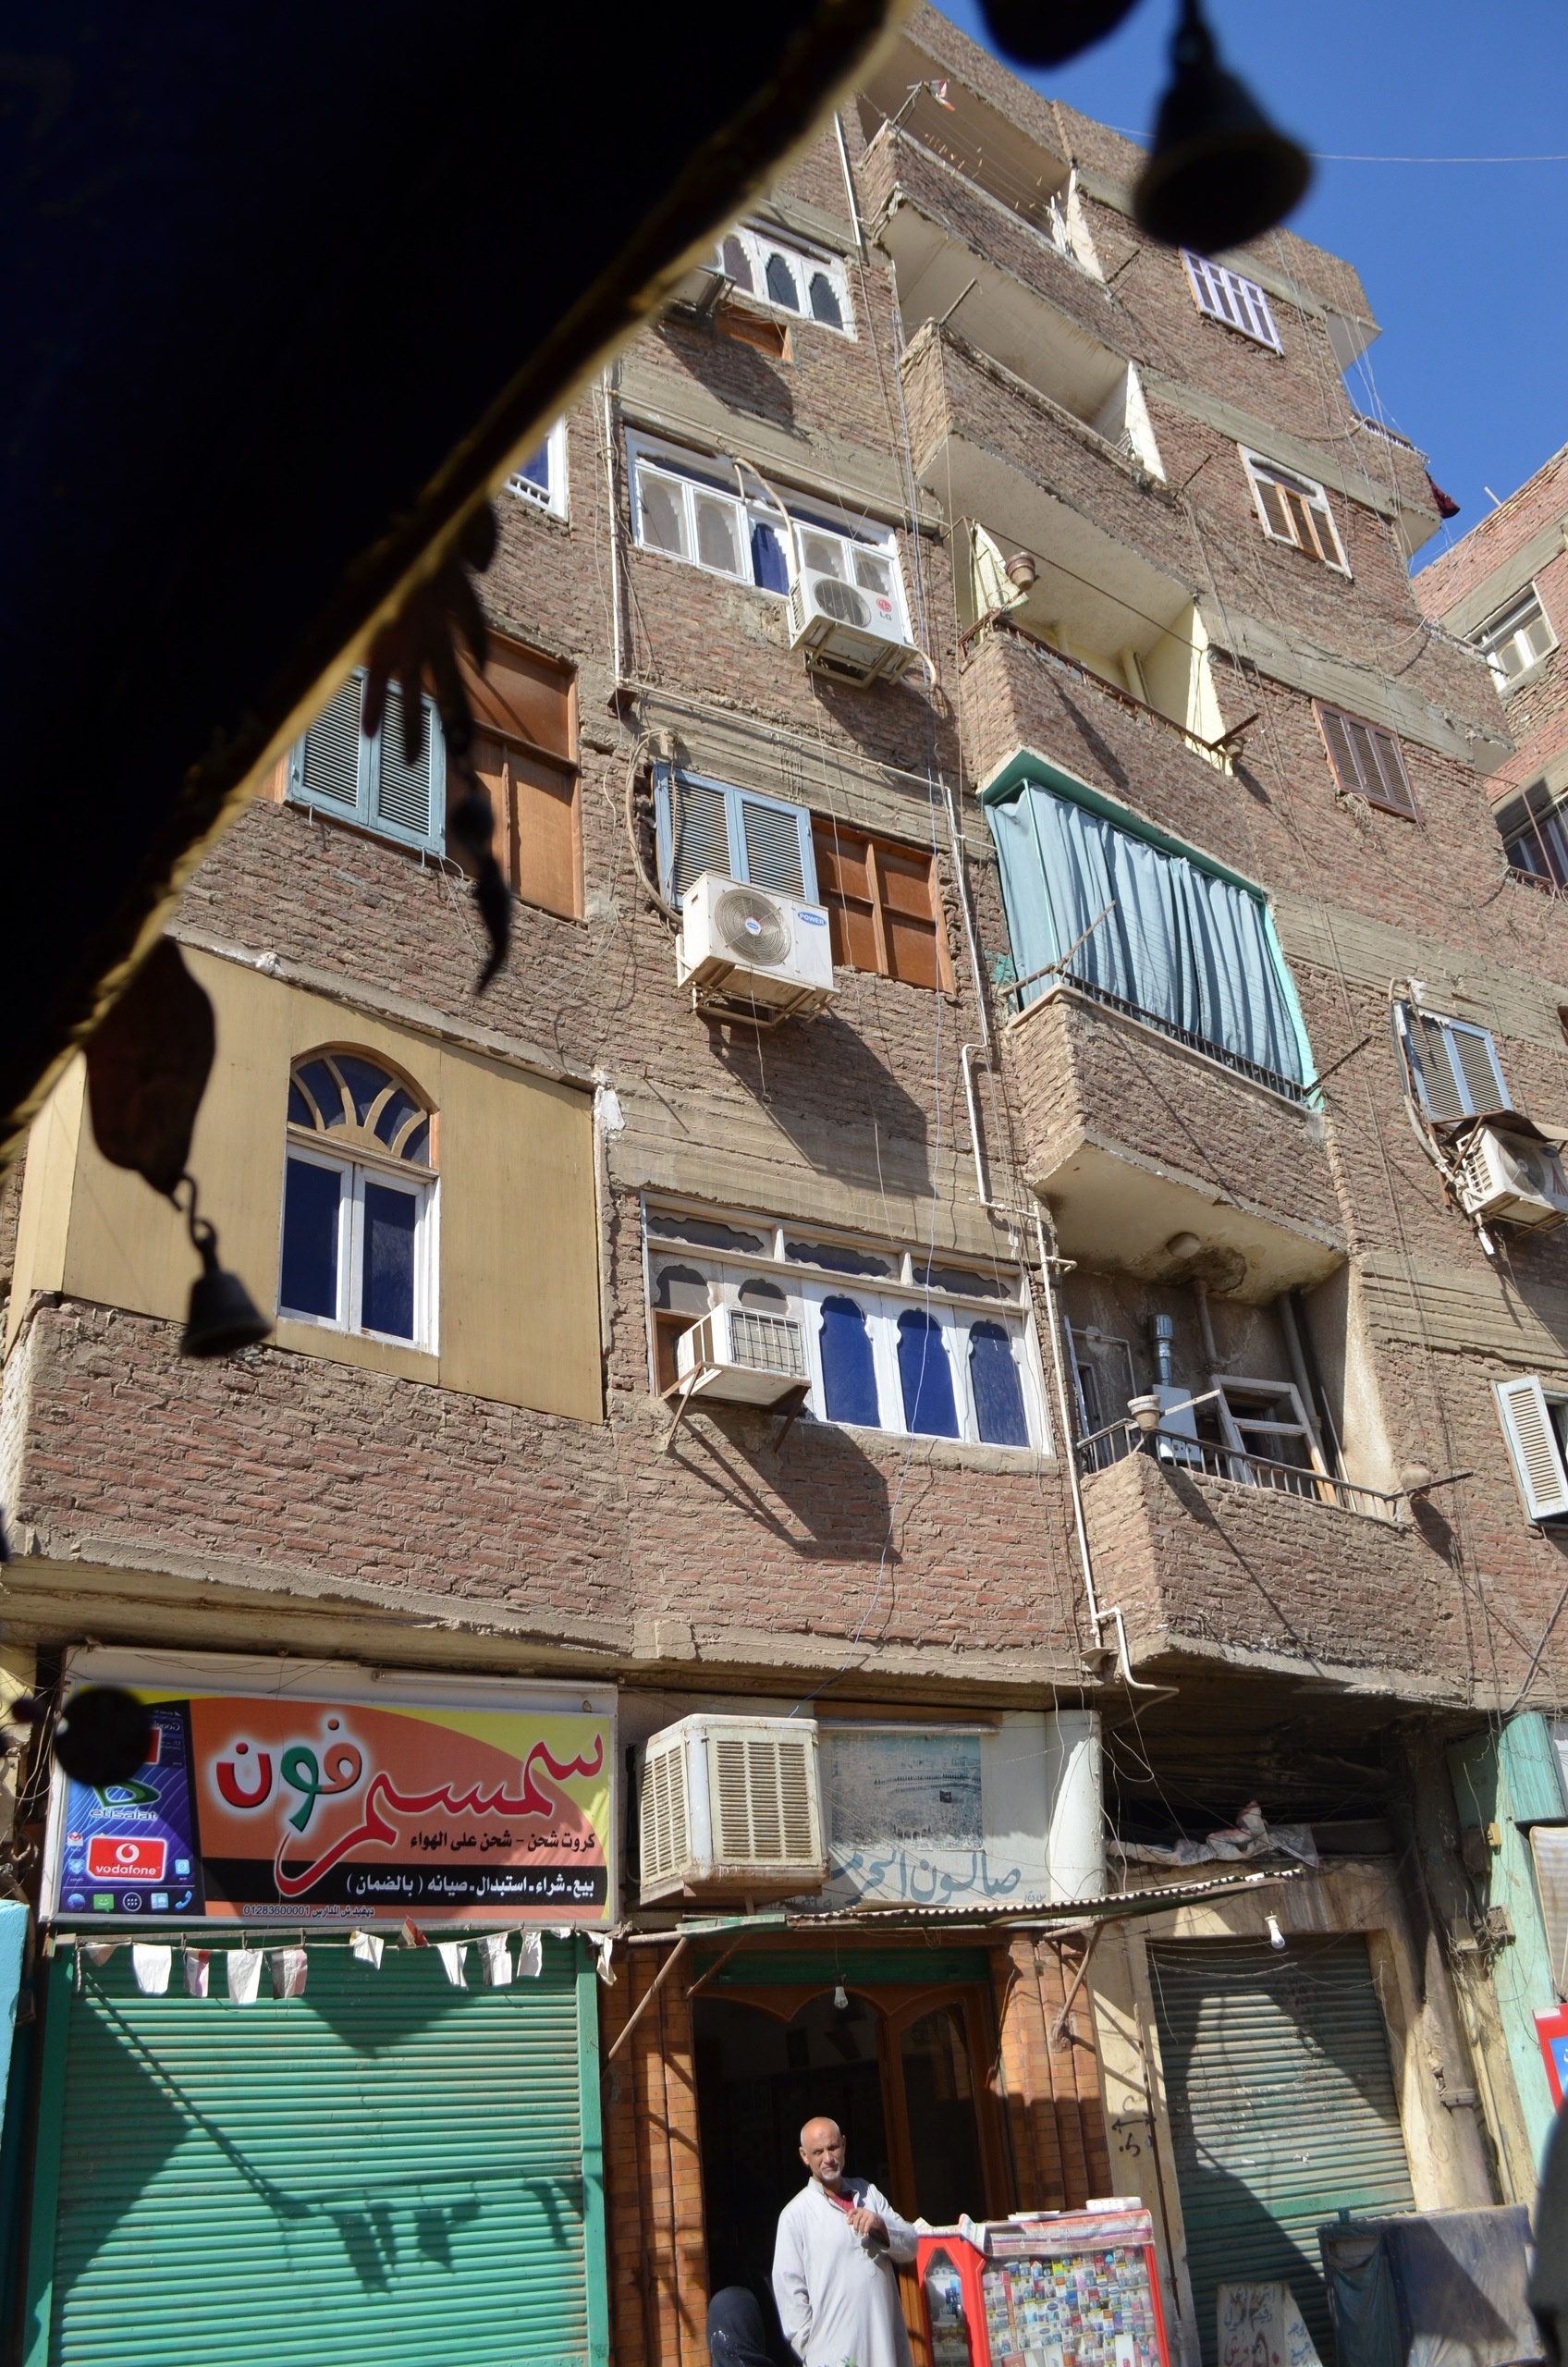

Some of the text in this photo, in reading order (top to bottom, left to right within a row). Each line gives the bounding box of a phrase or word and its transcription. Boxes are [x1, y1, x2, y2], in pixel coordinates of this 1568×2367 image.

[879, 611, 892, 620] LG
[799, 914, 826, 926] POWER
[91, 1809, 158, 1821] etisalat
[216, 1717, 604, 1897] سمسم فون
[410, 1830, 595, 1853] كروت شحن شحن على الهواء
[96, 1864, 157, 1876] vodafone
[910, 1850, 1022, 1905] صالون
[427, 1873, 469, 1897] صيانه
[475, 1875, 528, 1896] استبدال
[534, 1873, 566, 1896] شراء
[571, 1877, 594, 1897] بيع
[243, 1904, 311, 1917] 01283600001
